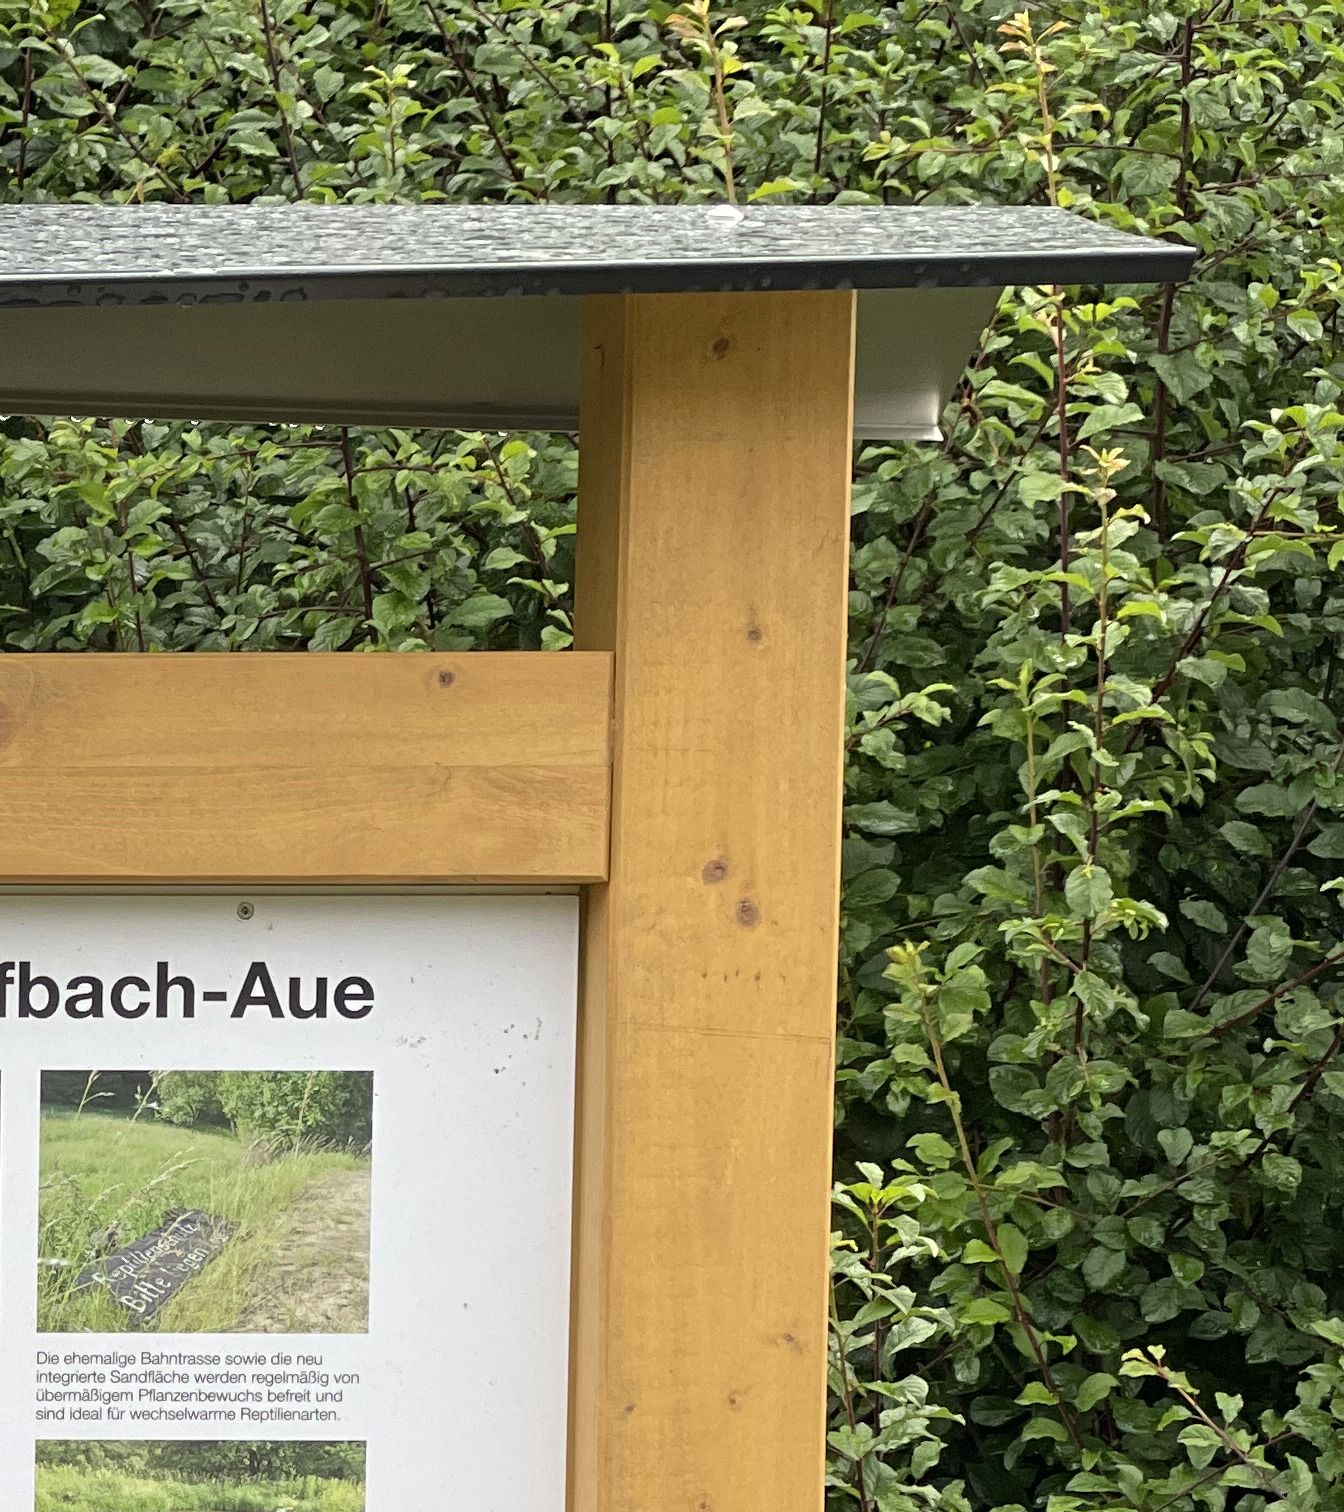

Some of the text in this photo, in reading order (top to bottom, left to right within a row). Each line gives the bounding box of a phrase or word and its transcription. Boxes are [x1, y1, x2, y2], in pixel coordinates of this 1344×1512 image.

[36, 1350, 323, 1369] Die ehemalige Bahntrasse sowie die neu
[35, 1369, 360, 1388] integrierte Sandfläche werden regelmäßig von
[35, 1387, 344, 1406] übermäßigem Pflanzenbewuchs befreit und
[35, 1406, 342, 1424] sind ideal für wechselwarme Reptilienarten.
